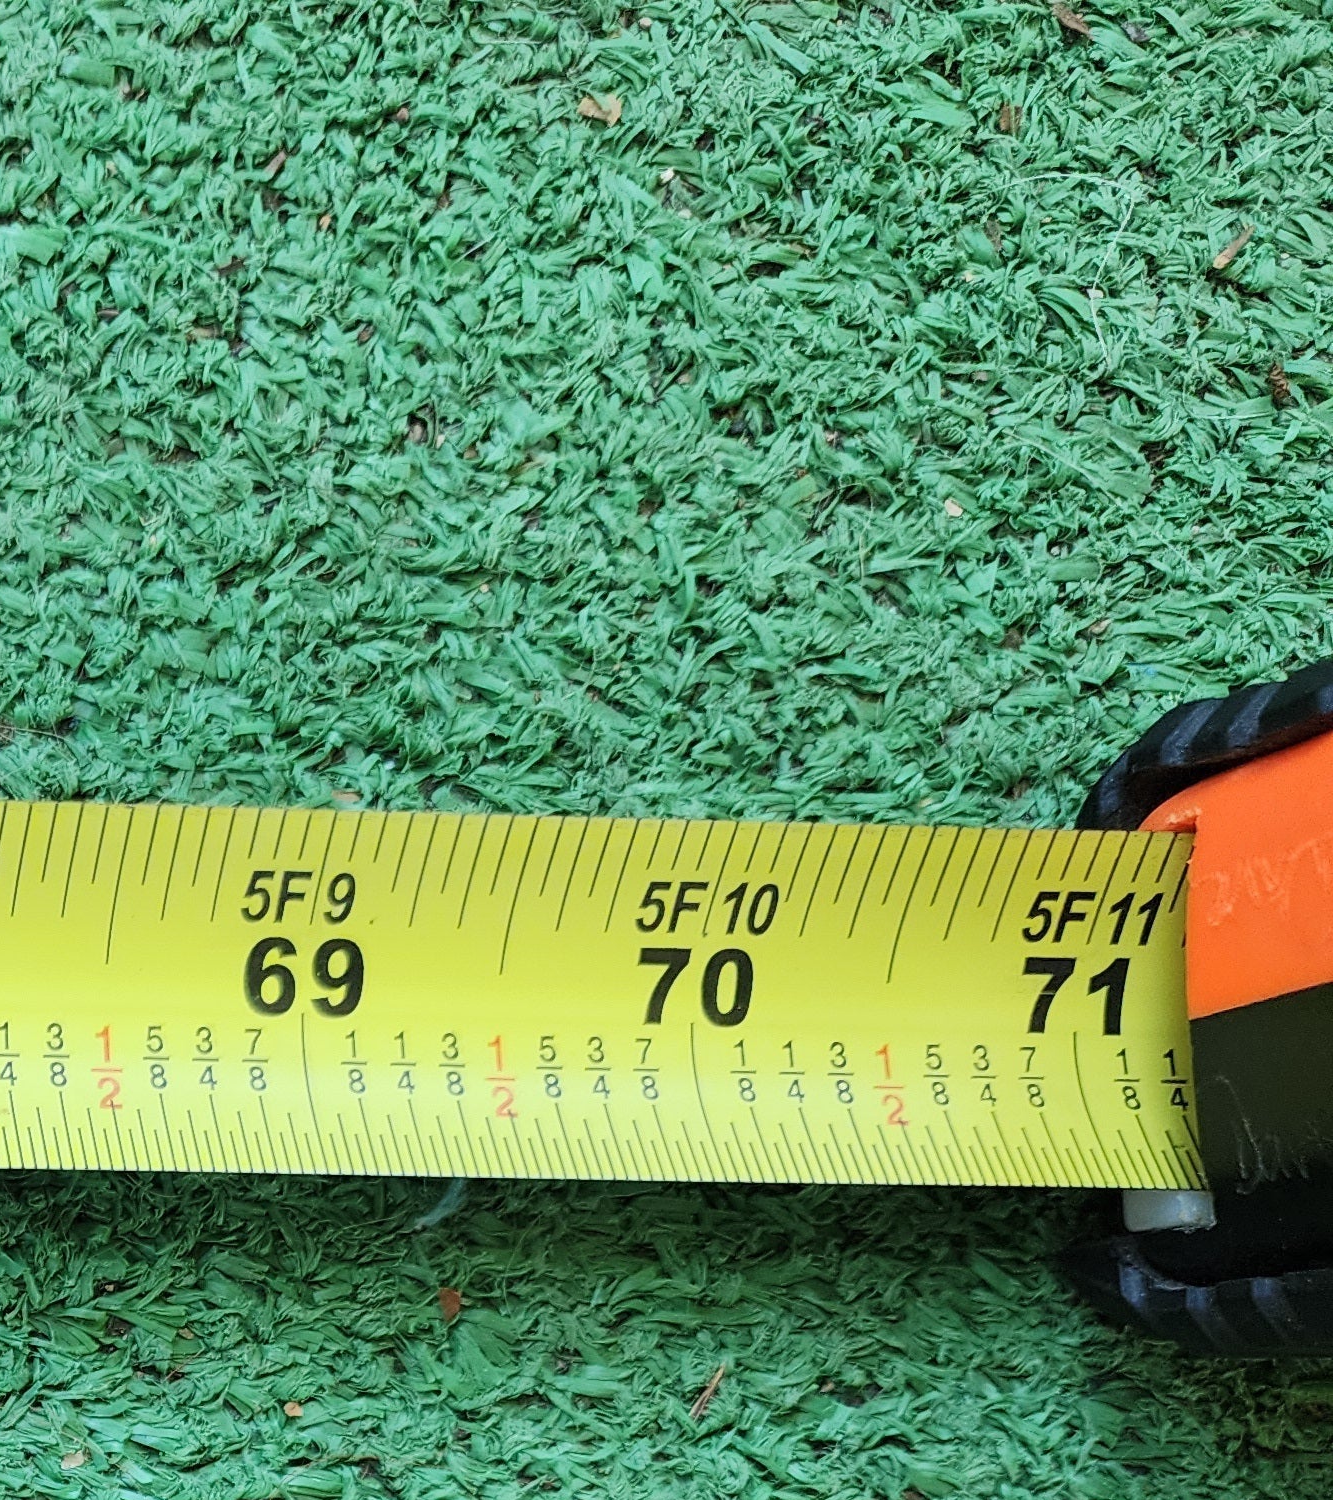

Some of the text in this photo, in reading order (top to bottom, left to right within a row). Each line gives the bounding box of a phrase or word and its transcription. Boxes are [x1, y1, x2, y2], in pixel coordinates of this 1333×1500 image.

[244, 937, 365, 1018] 69
[638, 948, 754, 1027] 70
[1022, 957, 1132, 1036] 71
